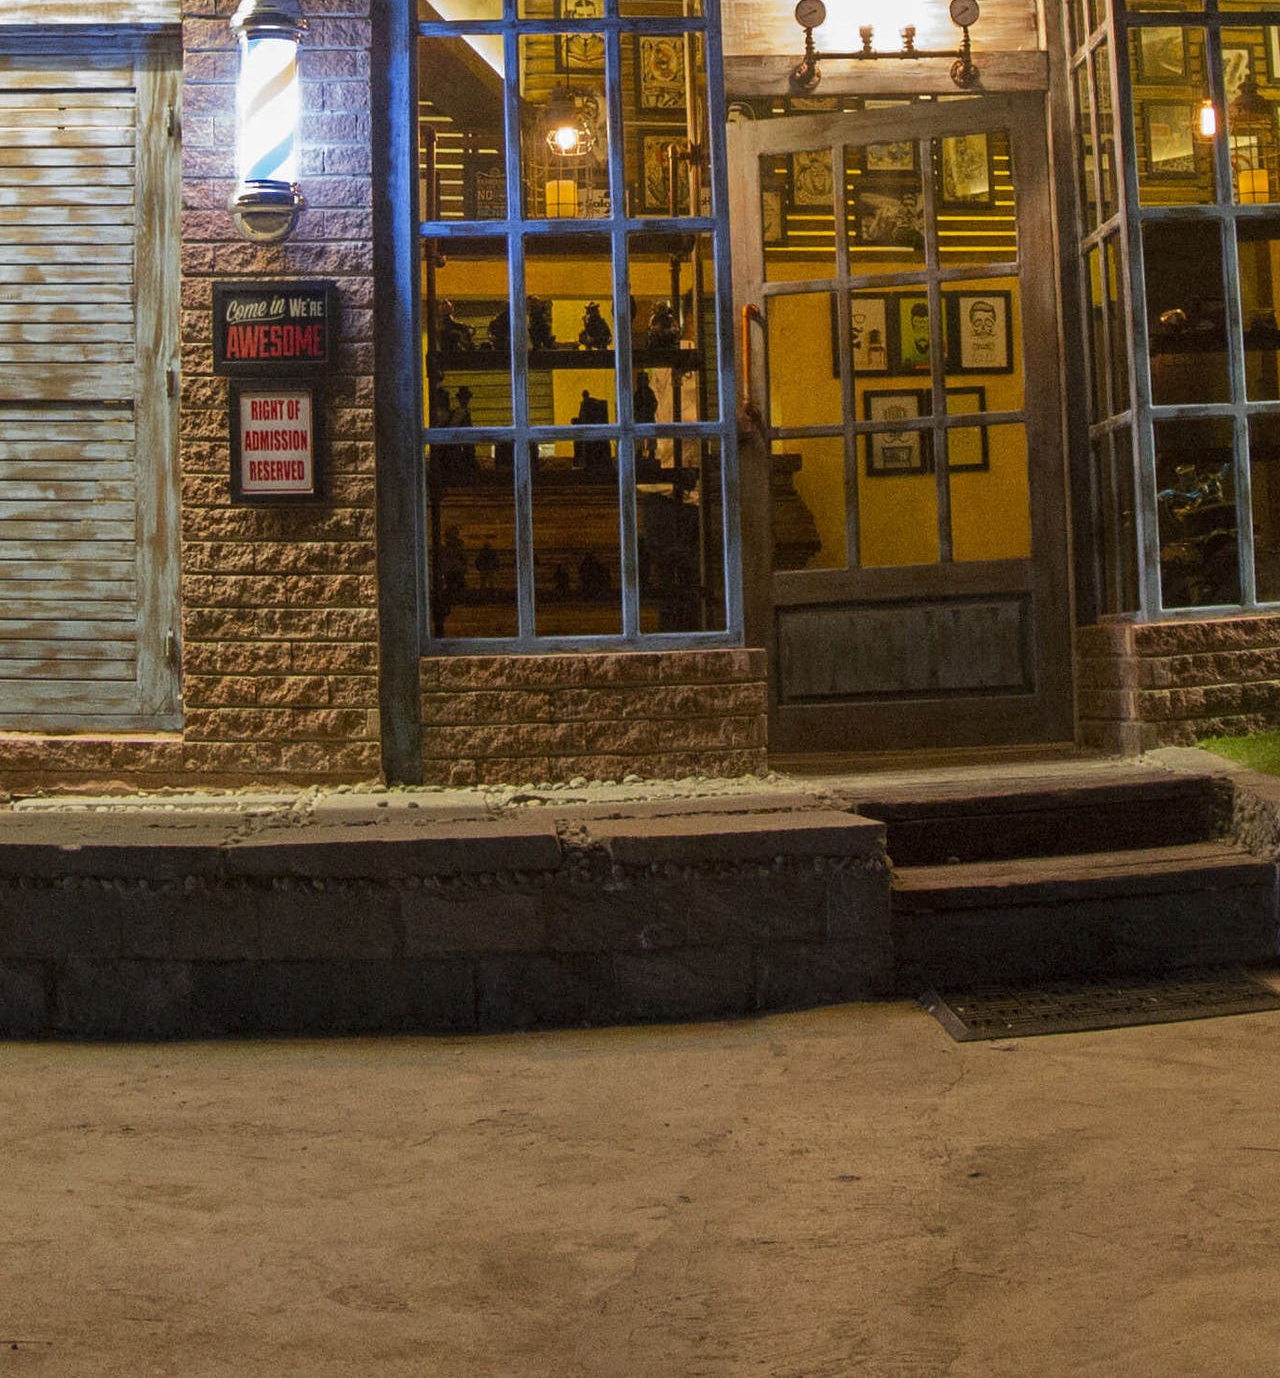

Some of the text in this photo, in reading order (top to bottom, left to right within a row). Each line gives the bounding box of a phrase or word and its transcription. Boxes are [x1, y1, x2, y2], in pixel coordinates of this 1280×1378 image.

[226, 299, 268, 322] Come
[270, 296, 286, 315] in
[226, 325, 325, 360] AWESOME
[250, 399, 301, 421] RIGHT OF
[245, 429, 308, 452] ADMISSION
[249, 460, 305, 482] RESERVED
